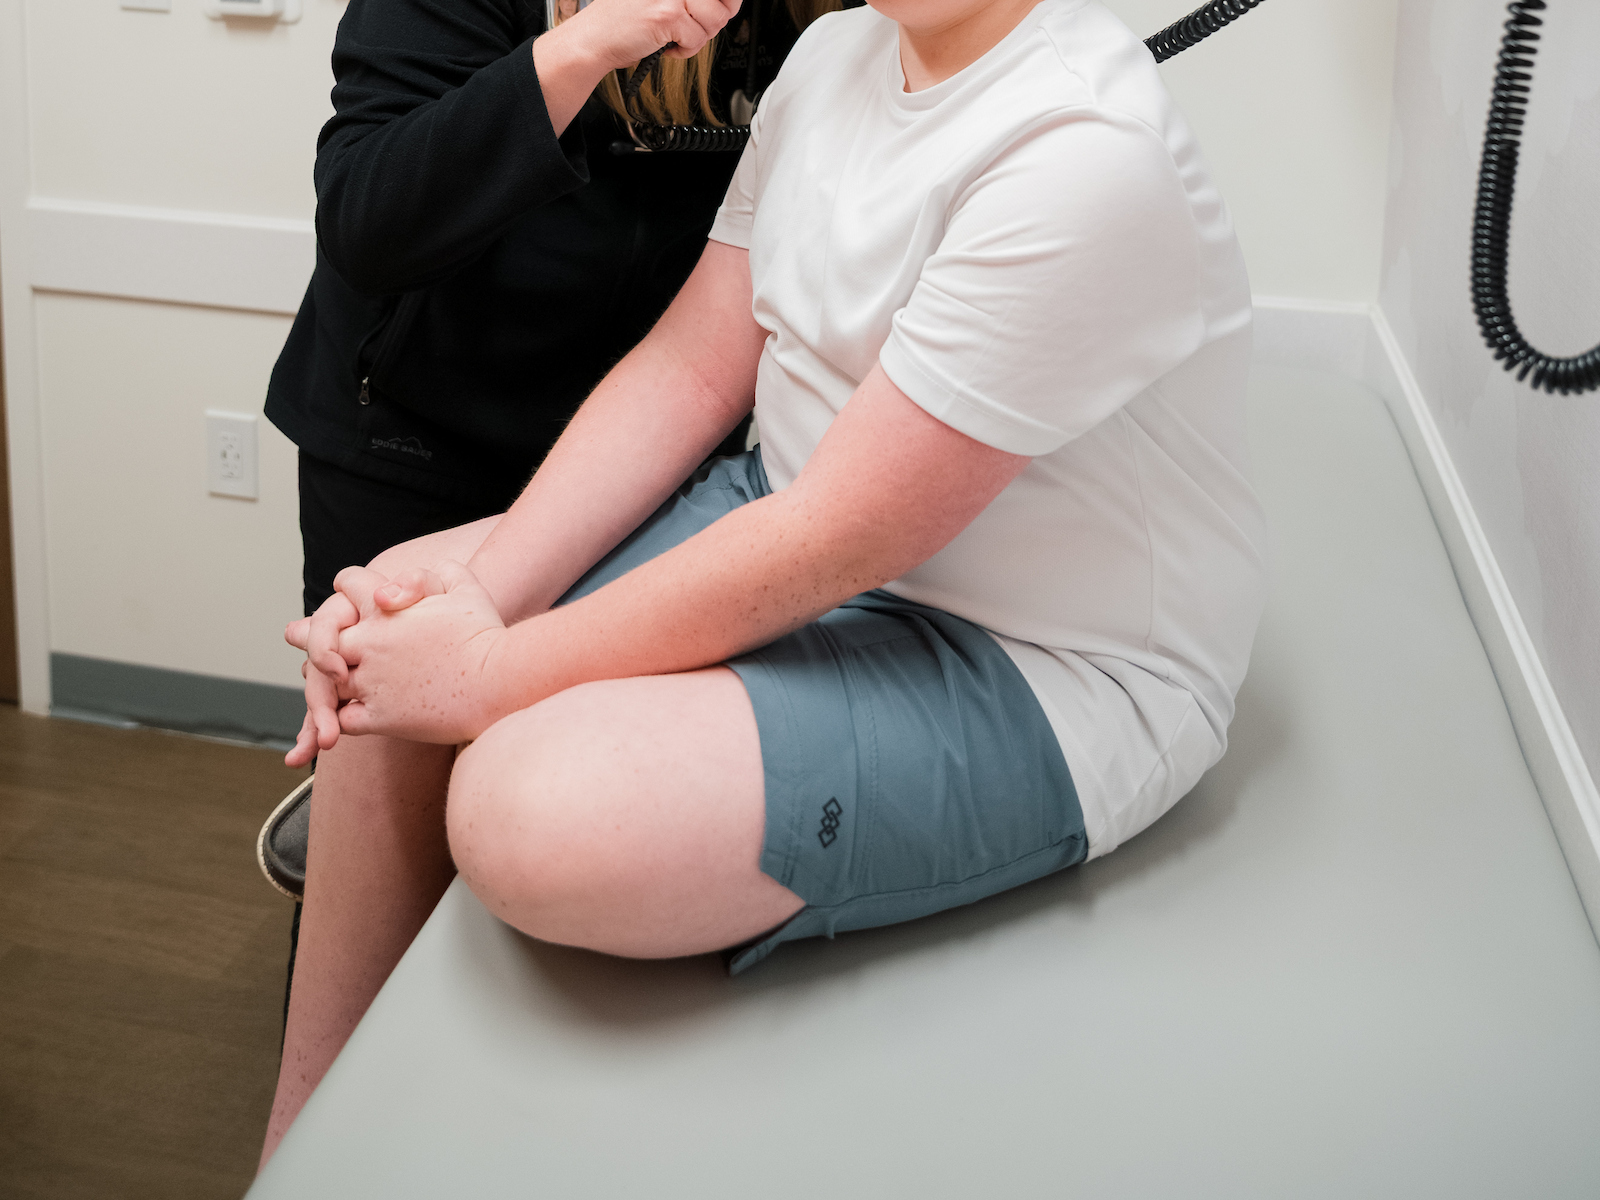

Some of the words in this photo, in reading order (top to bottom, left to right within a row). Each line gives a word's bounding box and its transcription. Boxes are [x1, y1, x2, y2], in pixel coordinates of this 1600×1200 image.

[720, 54, 774, 70] childn's
[371, 437, 398, 450] EDDIE
[401, 444, 433, 458] BAUER
